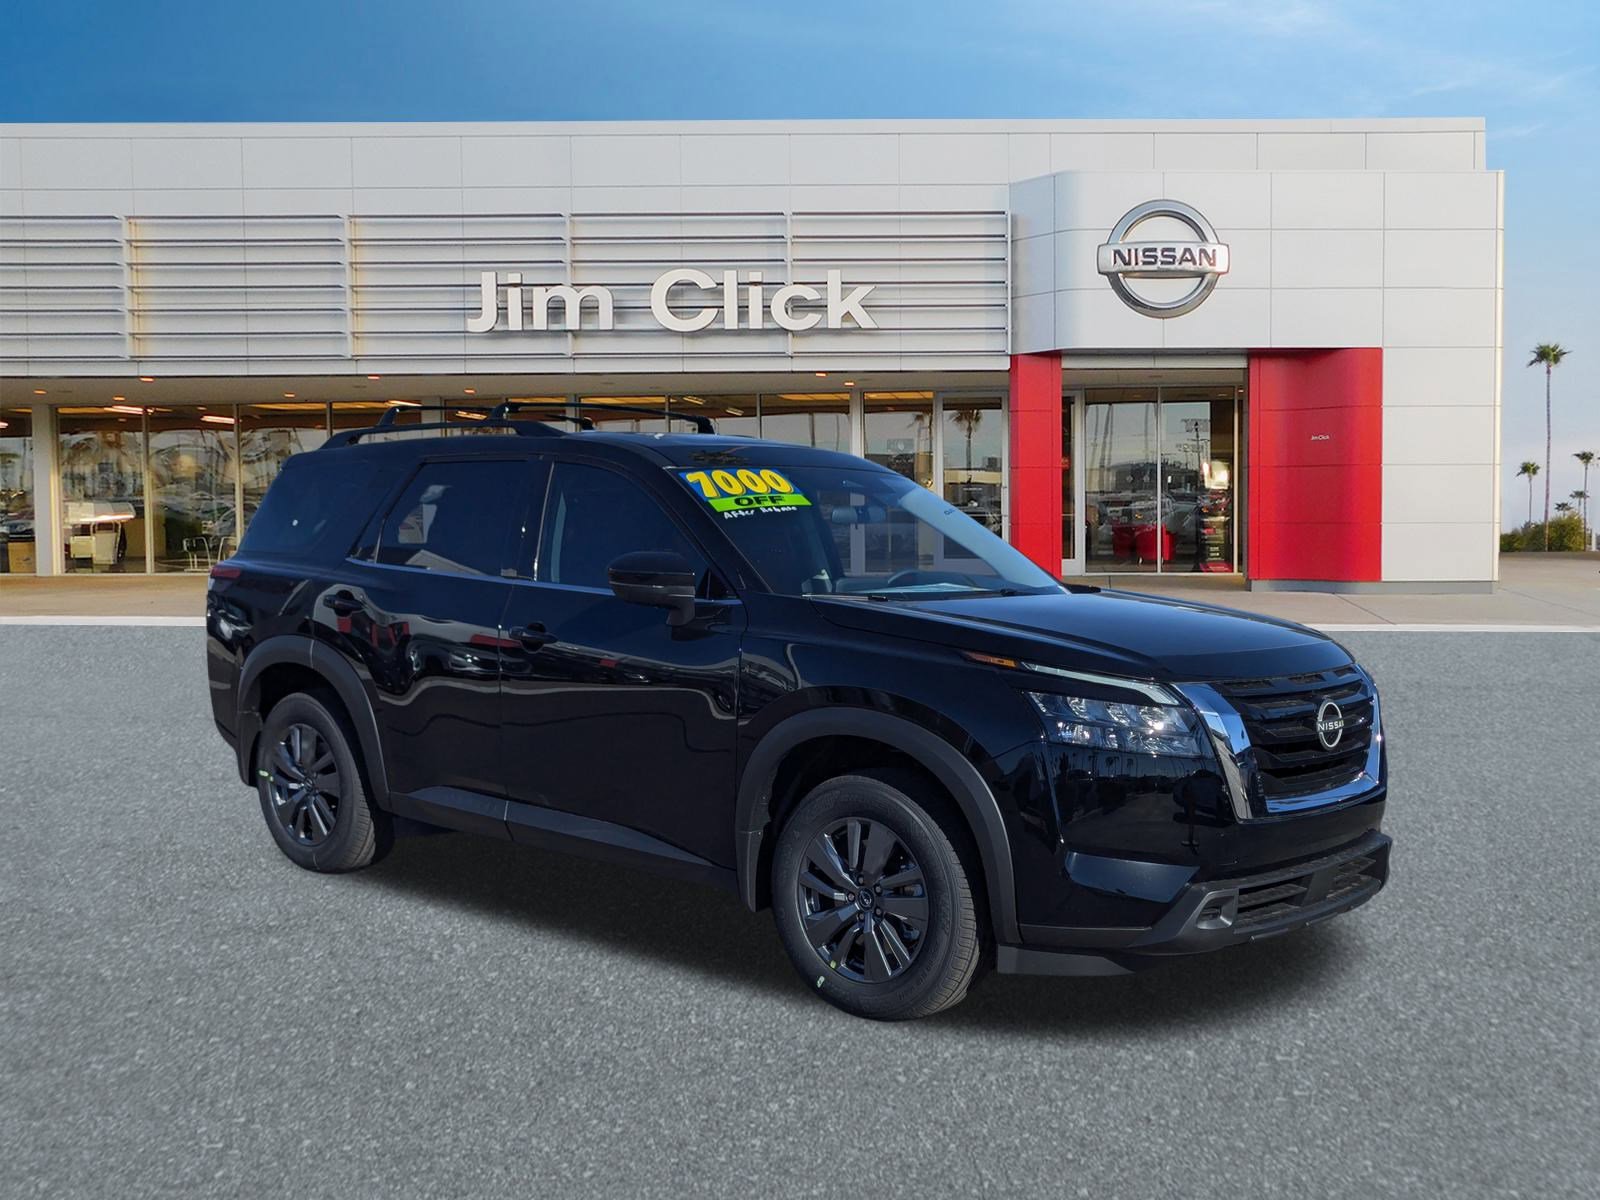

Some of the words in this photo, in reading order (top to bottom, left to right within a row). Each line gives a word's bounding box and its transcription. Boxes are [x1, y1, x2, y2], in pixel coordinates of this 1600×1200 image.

[1112, 247, 1217, 267] NISSAN
[467, 271, 614, 333] Jim
[650, 269, 879, 332] Click
[686, 469, 794, 498] 7000
[734, 495, 785, 506] OFF
